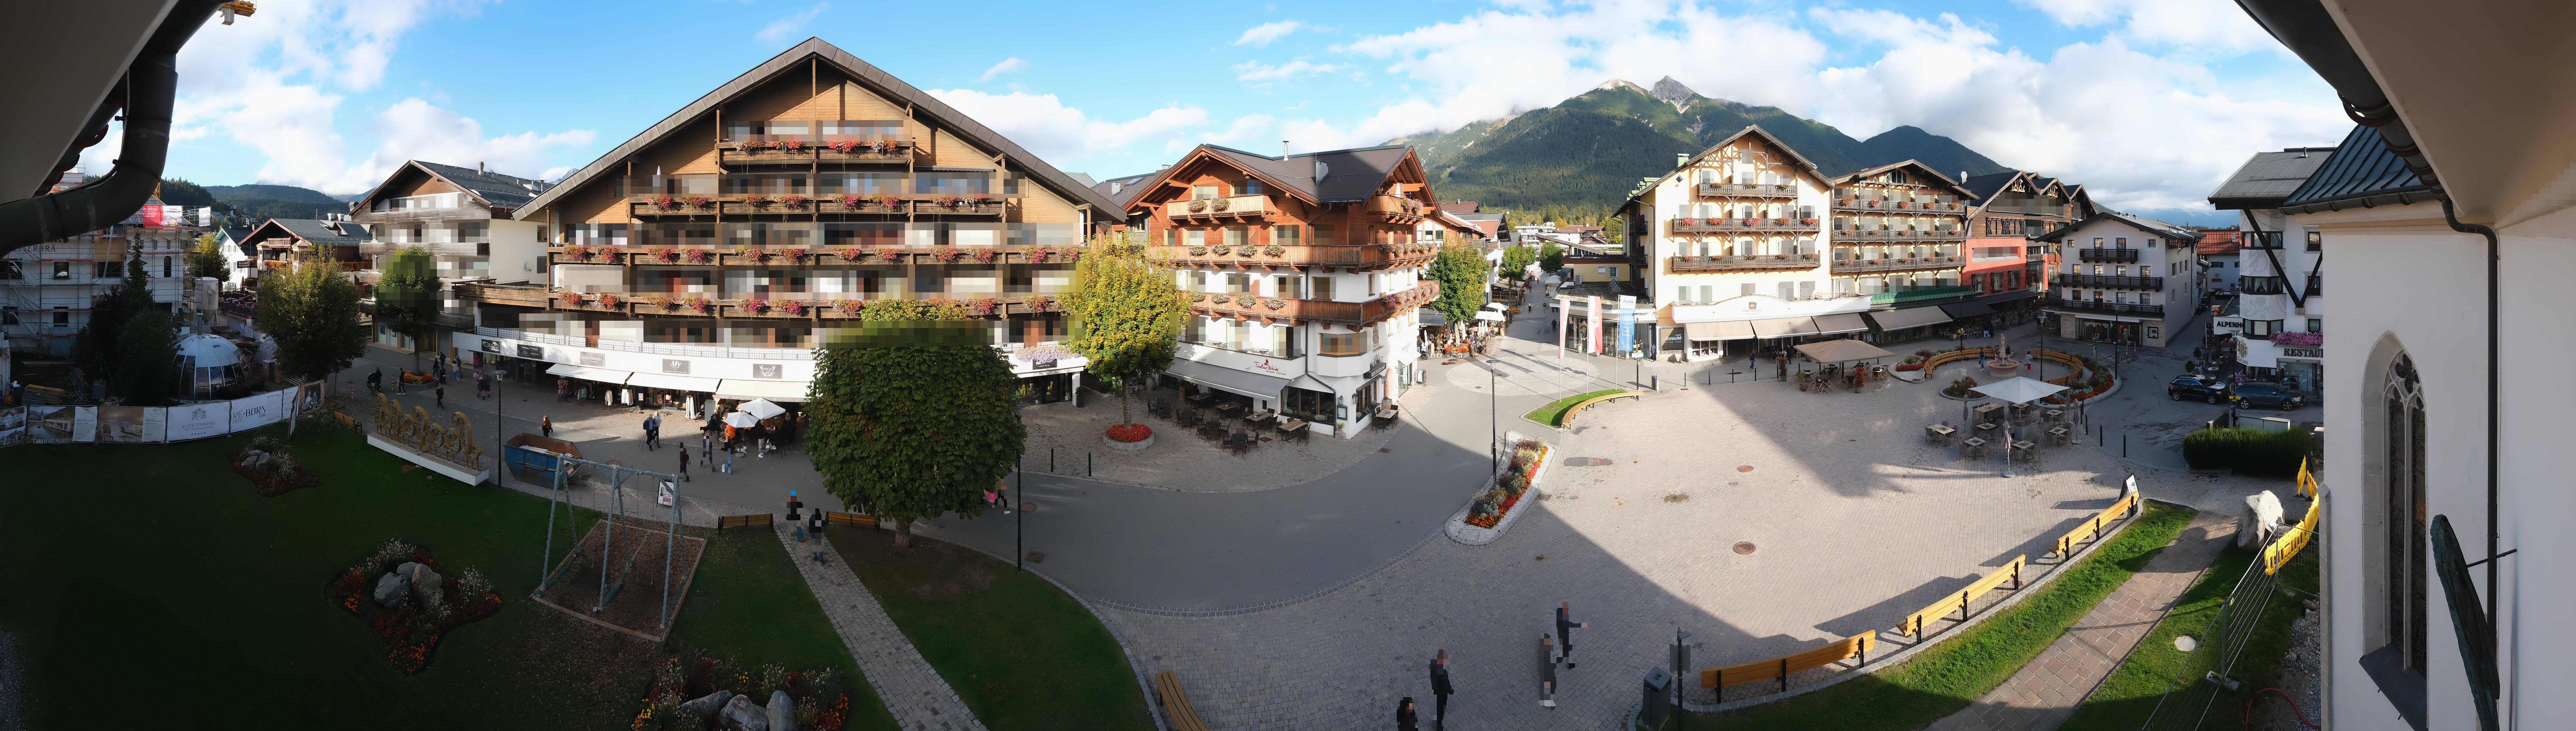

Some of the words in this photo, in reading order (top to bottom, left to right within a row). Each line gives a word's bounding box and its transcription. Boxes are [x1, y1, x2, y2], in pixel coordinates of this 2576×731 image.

[1402, 343, 1410, 351] SAILER
[2237, 355, 2248, 364] Kaltschmid
[670, 360, 681, 370] My
[1371, 364, 1385, 377] RESTAURANT
